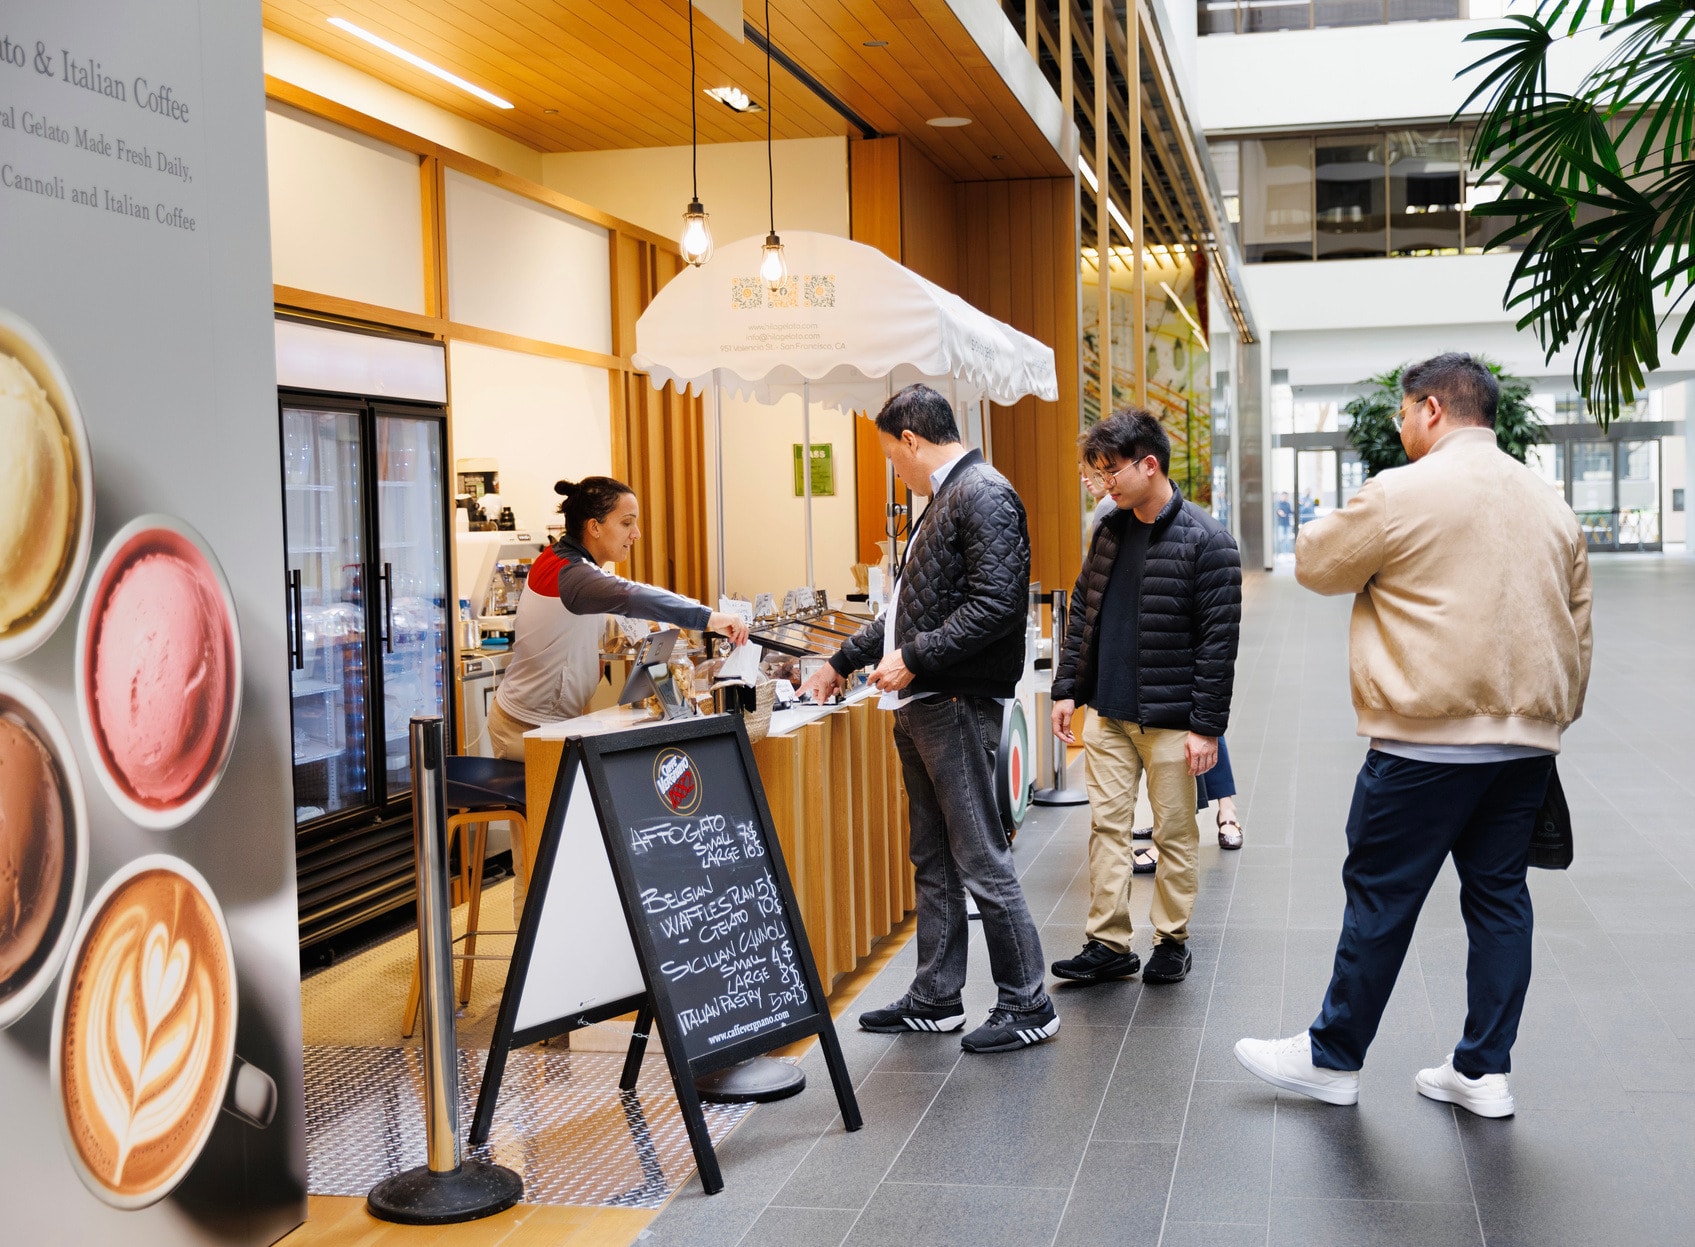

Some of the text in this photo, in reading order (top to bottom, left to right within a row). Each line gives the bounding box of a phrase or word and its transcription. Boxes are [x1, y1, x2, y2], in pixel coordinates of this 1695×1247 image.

[0, 34, 190, 123] to & Italian Coffee
[0, 106, 193, 183] al Gelato Made Fresh Daily,
[2, 164, 196, 232] Cannoli and Italian Coffee
[720, 344, 732, 352] 951
[734, 343, 764, 352] Valencia
[835, 342, 846, 350] CA
[669, 771, 695, 810] 1882
[630, 814, 726, 852] AFFOGATO
[693, 821, 757, 856] SMALL 7$
[702, 840, 765, 868] LARGE 10$
[640, 874, 714, 913] BELGIAN
[660, 896, 733, 939] WAFFLES
[755, 867, 777, 900] 5$
[699, 909, 748, 943] GELATO
[757, 897, 782, 918] 10$
[660, 920, 787, 982] SICILIAN CANNOLI
[720, 939, 793, 978] SMALL 4$
[728, 962, 801, 995] LARGE 8$
[677, 996, 720, 1036] ITALIAN
[720, 987, 762, 1013] PASTRY
[708, 1010, 790, 1045] www.caffevergnano.com
